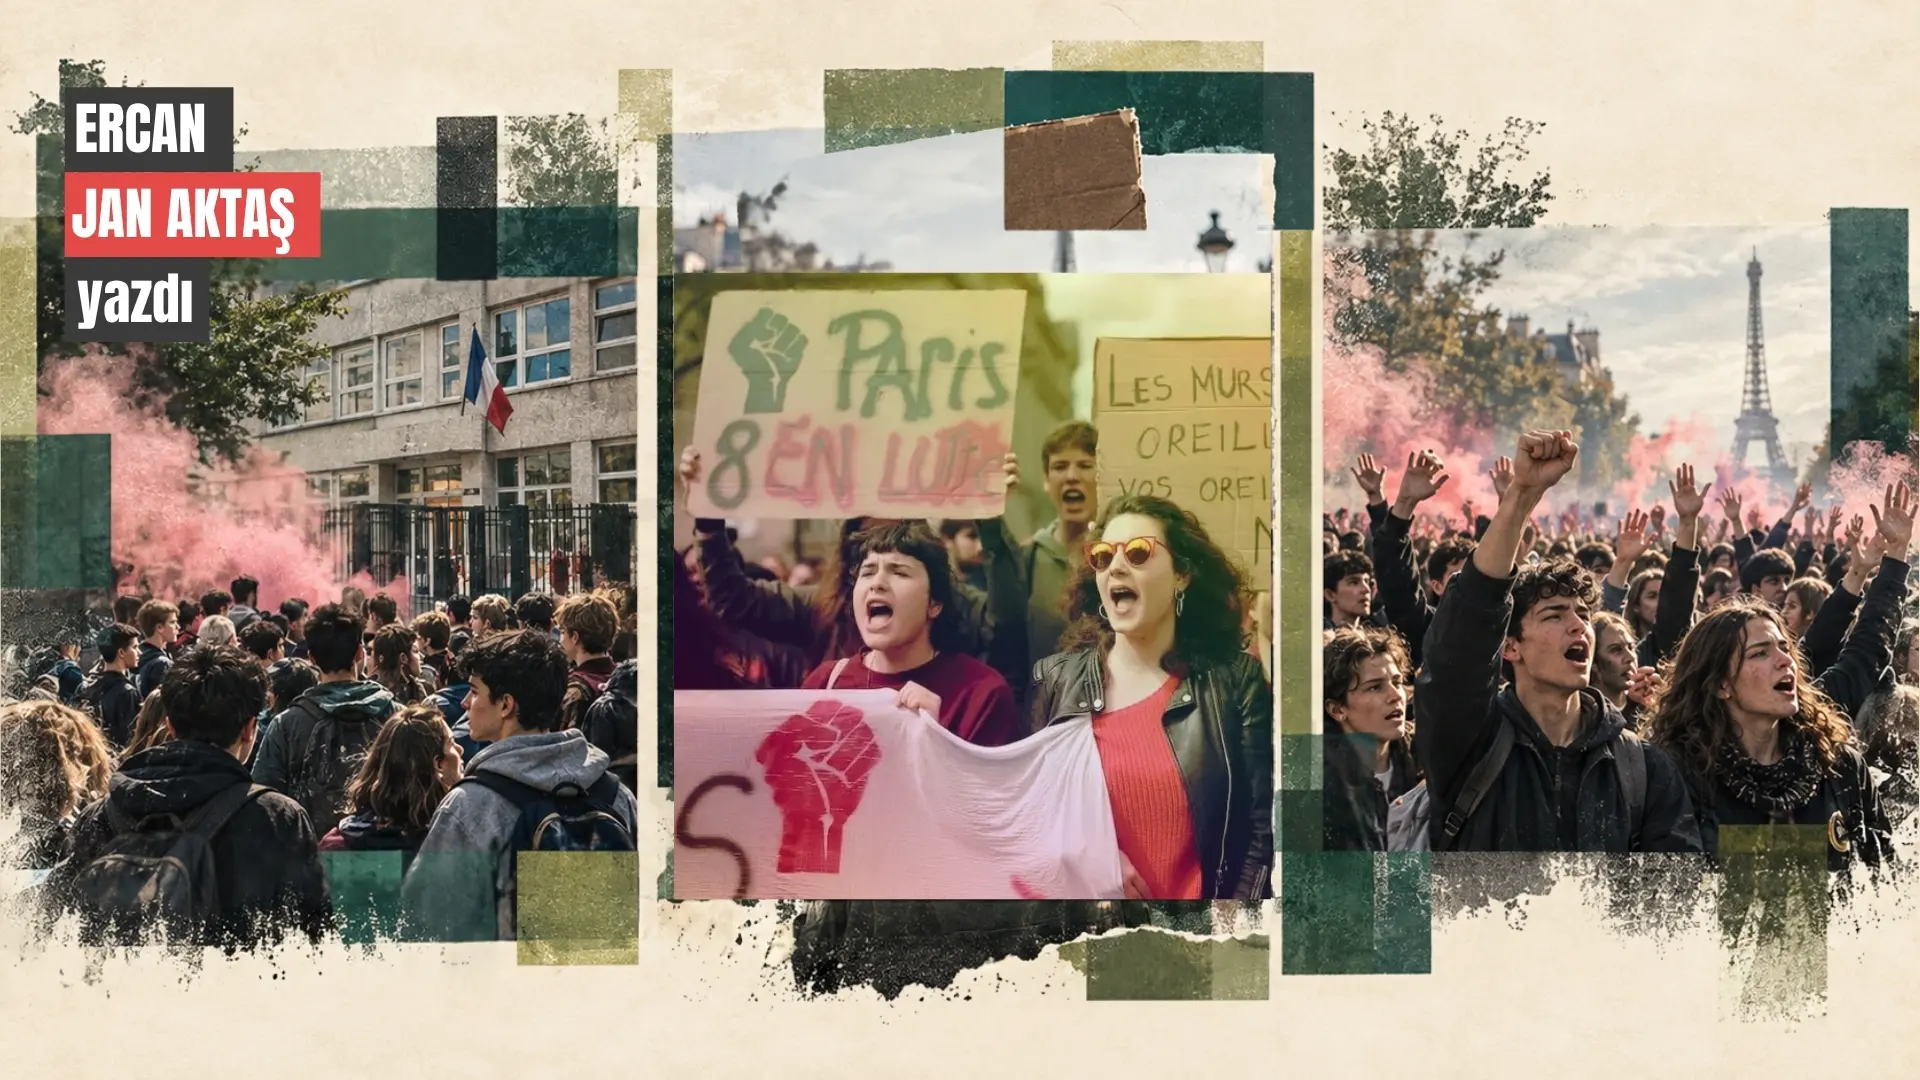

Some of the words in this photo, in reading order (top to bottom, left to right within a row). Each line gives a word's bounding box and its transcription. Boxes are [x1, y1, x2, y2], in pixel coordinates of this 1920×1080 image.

[1108, 353, 1173, 407] LES
[1190, 363, 1271, 404] MURS
[707, 419, 761, 509] 8
[763, 414, 859, 510] EN
[1117, 475, 1173, 499] VOS
[1199, 474, 1267, 503] OREI
